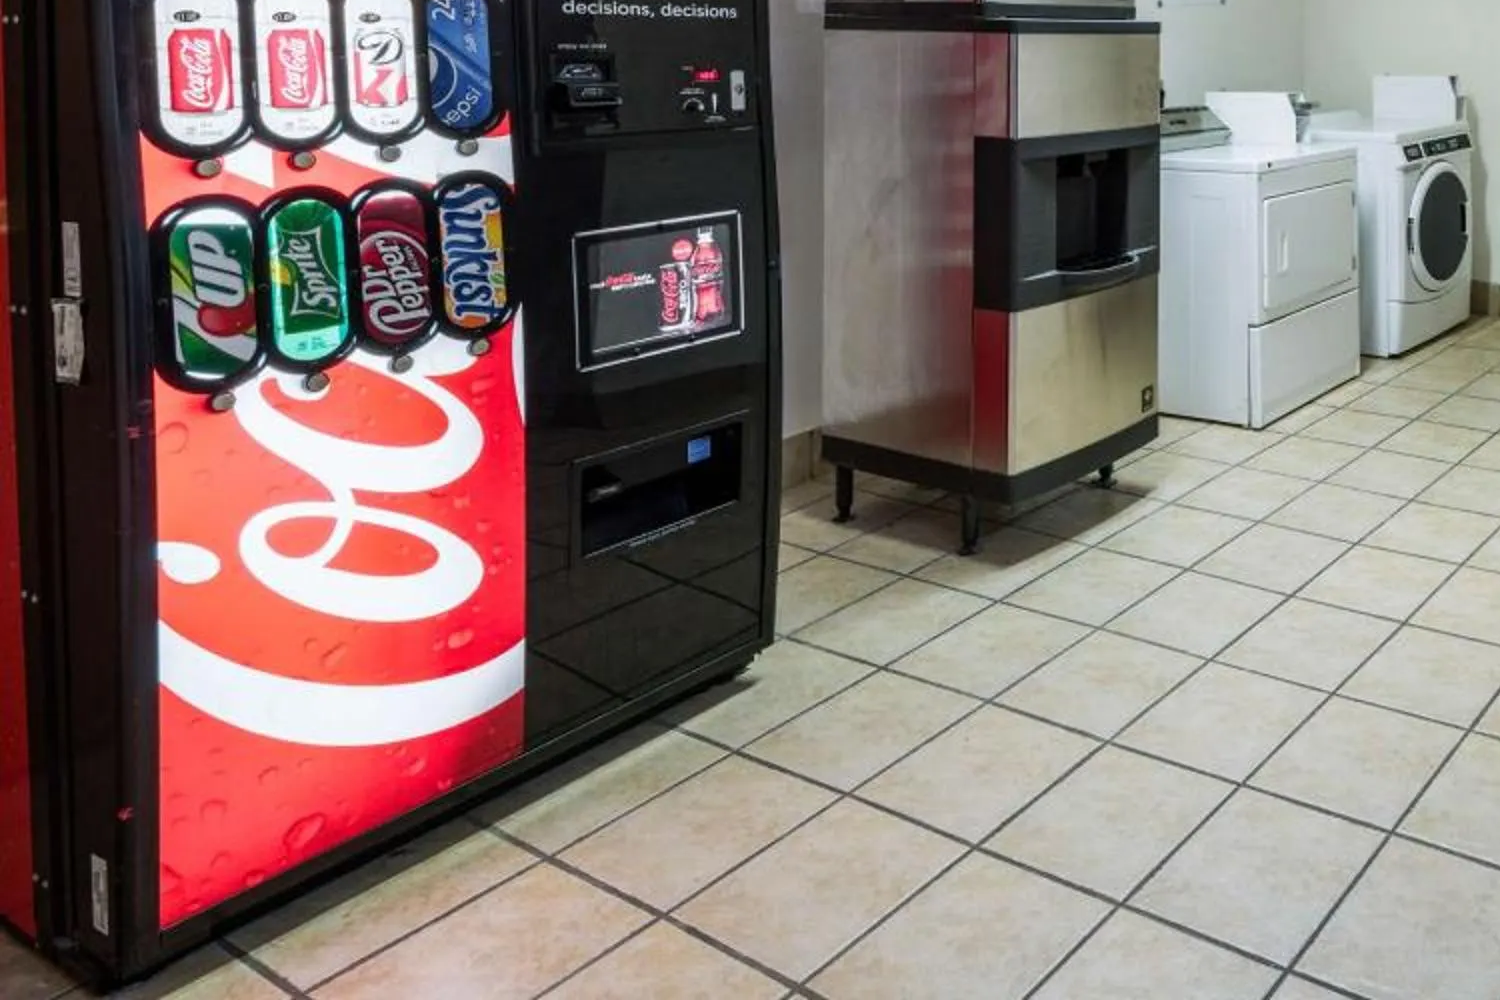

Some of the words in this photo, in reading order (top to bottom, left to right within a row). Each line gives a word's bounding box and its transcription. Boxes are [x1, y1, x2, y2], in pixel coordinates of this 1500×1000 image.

[562, 0, 655, 18] decisions,
[660, 3, 737, 19] decisions
[283, 236, 338, 308] Sprite
[362, 264, 397, 303] Dr
[369, 237, 433, 335] Pepper
[442, 184, 506, 322] Sunkist
